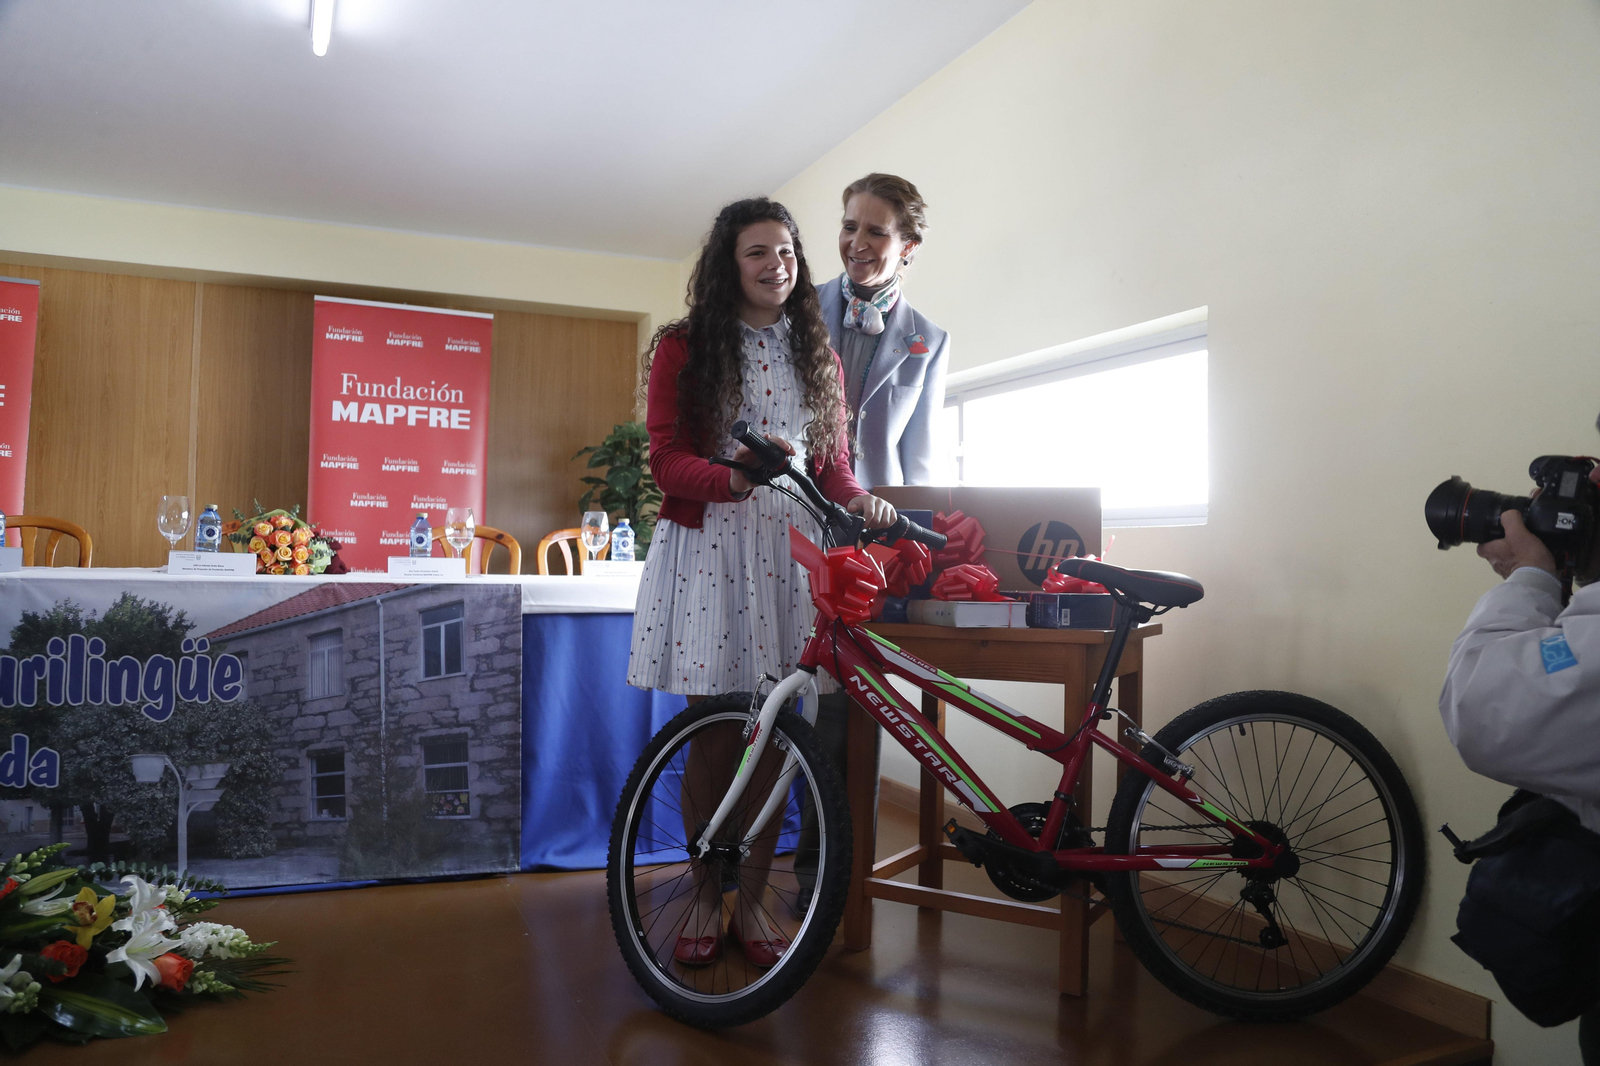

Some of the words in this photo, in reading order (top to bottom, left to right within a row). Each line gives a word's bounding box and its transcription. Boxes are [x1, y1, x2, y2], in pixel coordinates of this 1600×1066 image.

[328, 325, 363, 336] Fundación
[325, 332, 364, 343] MAPFRE
[388, 331, 422, 341] Fundación
[447, 336, 480, 346] Fundación
[386, 338, 424, 348] MAPFRE
[445, 343, 481, 353] MAPFRE
[339, 372, 465, 404] Fundación
[331, 400, 471, 430] MAPFRE
[322, 453, 358, 463] Fundación
[384, 456, 418, 466] Fundación
[320, 460, 359, 470] MAPFRE
[381, 463, 420, 473] MAPFRE
[443, 459, 476, 469] Fundación
[441, 466, 478, 476] MAPFRE
[352, 492, 387, 502] Fundación
[413, 494, 447, 504] Fundación
[350, 499, 389, 508] MAPFRE
[410, 501, 448, 510] MAPFRE
[320, 528, 355, 537] Fundación
[381, 530, 411, 538] Fundació
[379, 537, 411, 545] MAPFR
[848, 675, 958, 783] NEWSTAR
[0, 733, 60, 788] da
